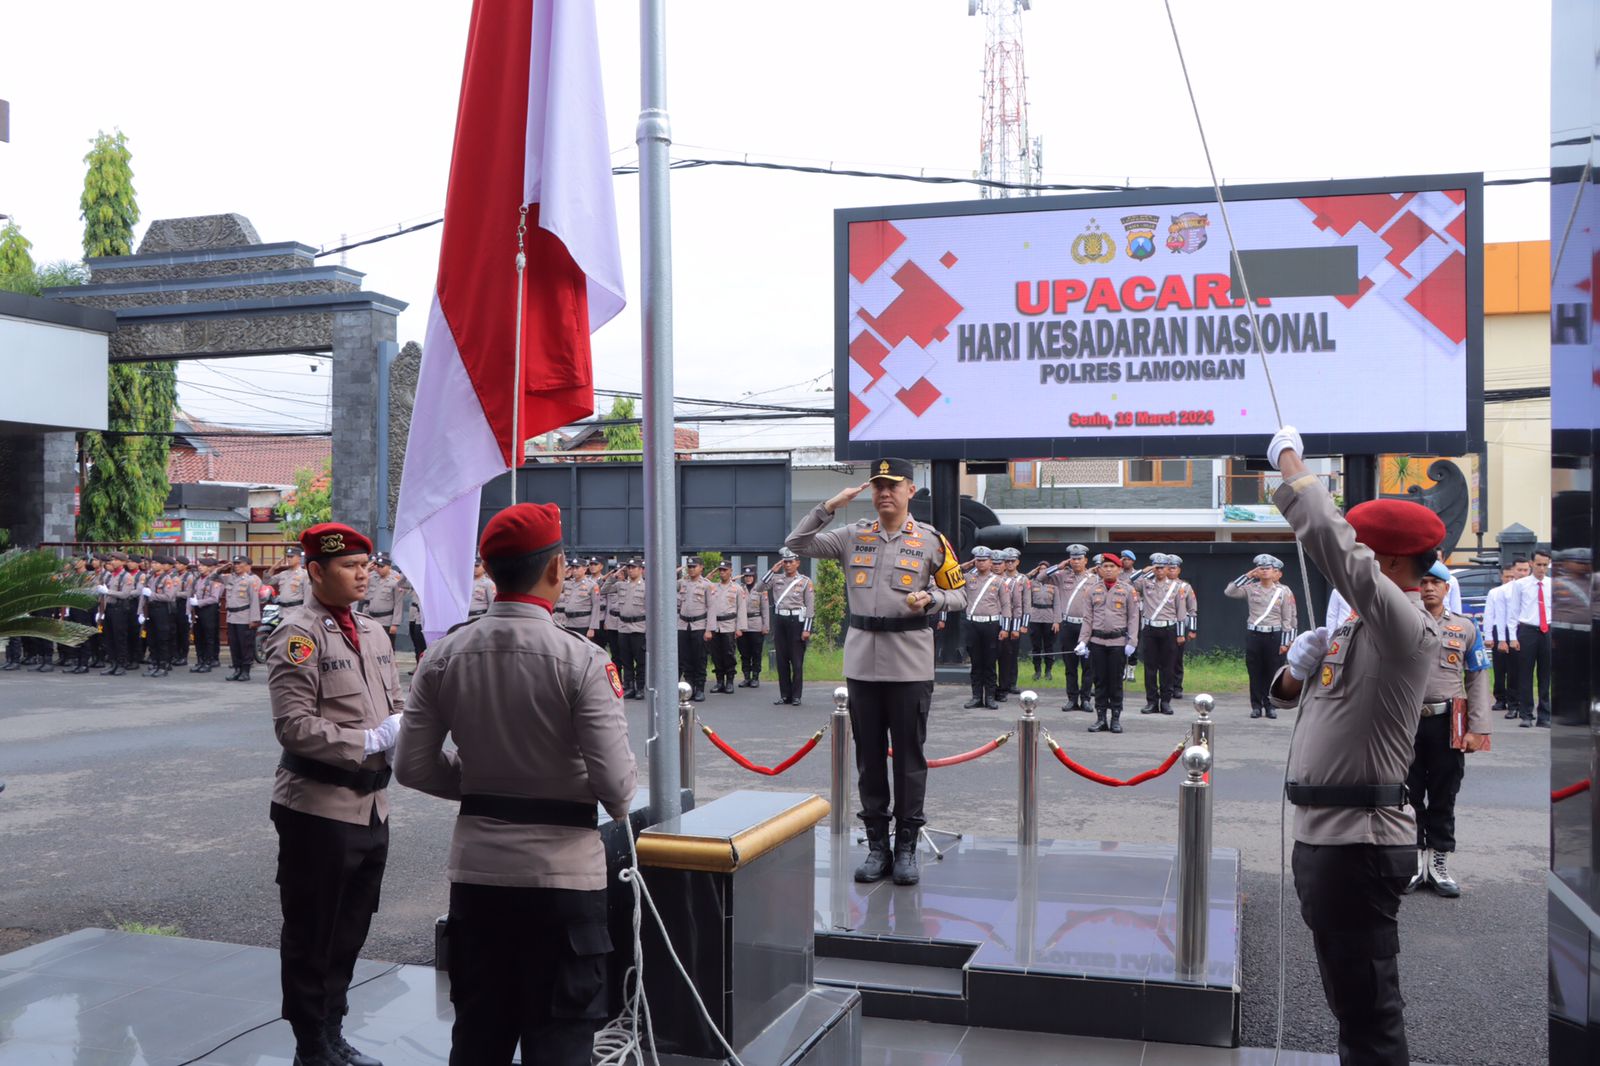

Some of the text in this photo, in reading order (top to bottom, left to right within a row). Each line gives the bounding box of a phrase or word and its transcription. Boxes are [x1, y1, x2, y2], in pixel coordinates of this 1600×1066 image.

[1016, 273, 1272, 316] UPACAR
[958, 312, 1336, 362] HARI KESADARAN NASIONAL
[1040, 358, 1246, 384] POLRES LAMONGAN
[1069, 409, 1215, 430] Senin, 18 Maret 2024
[900, 548, 924, 558] POLRI
[1442, 631, 1467, 639] POLRI
[322, 659, 353, 673] DENY
